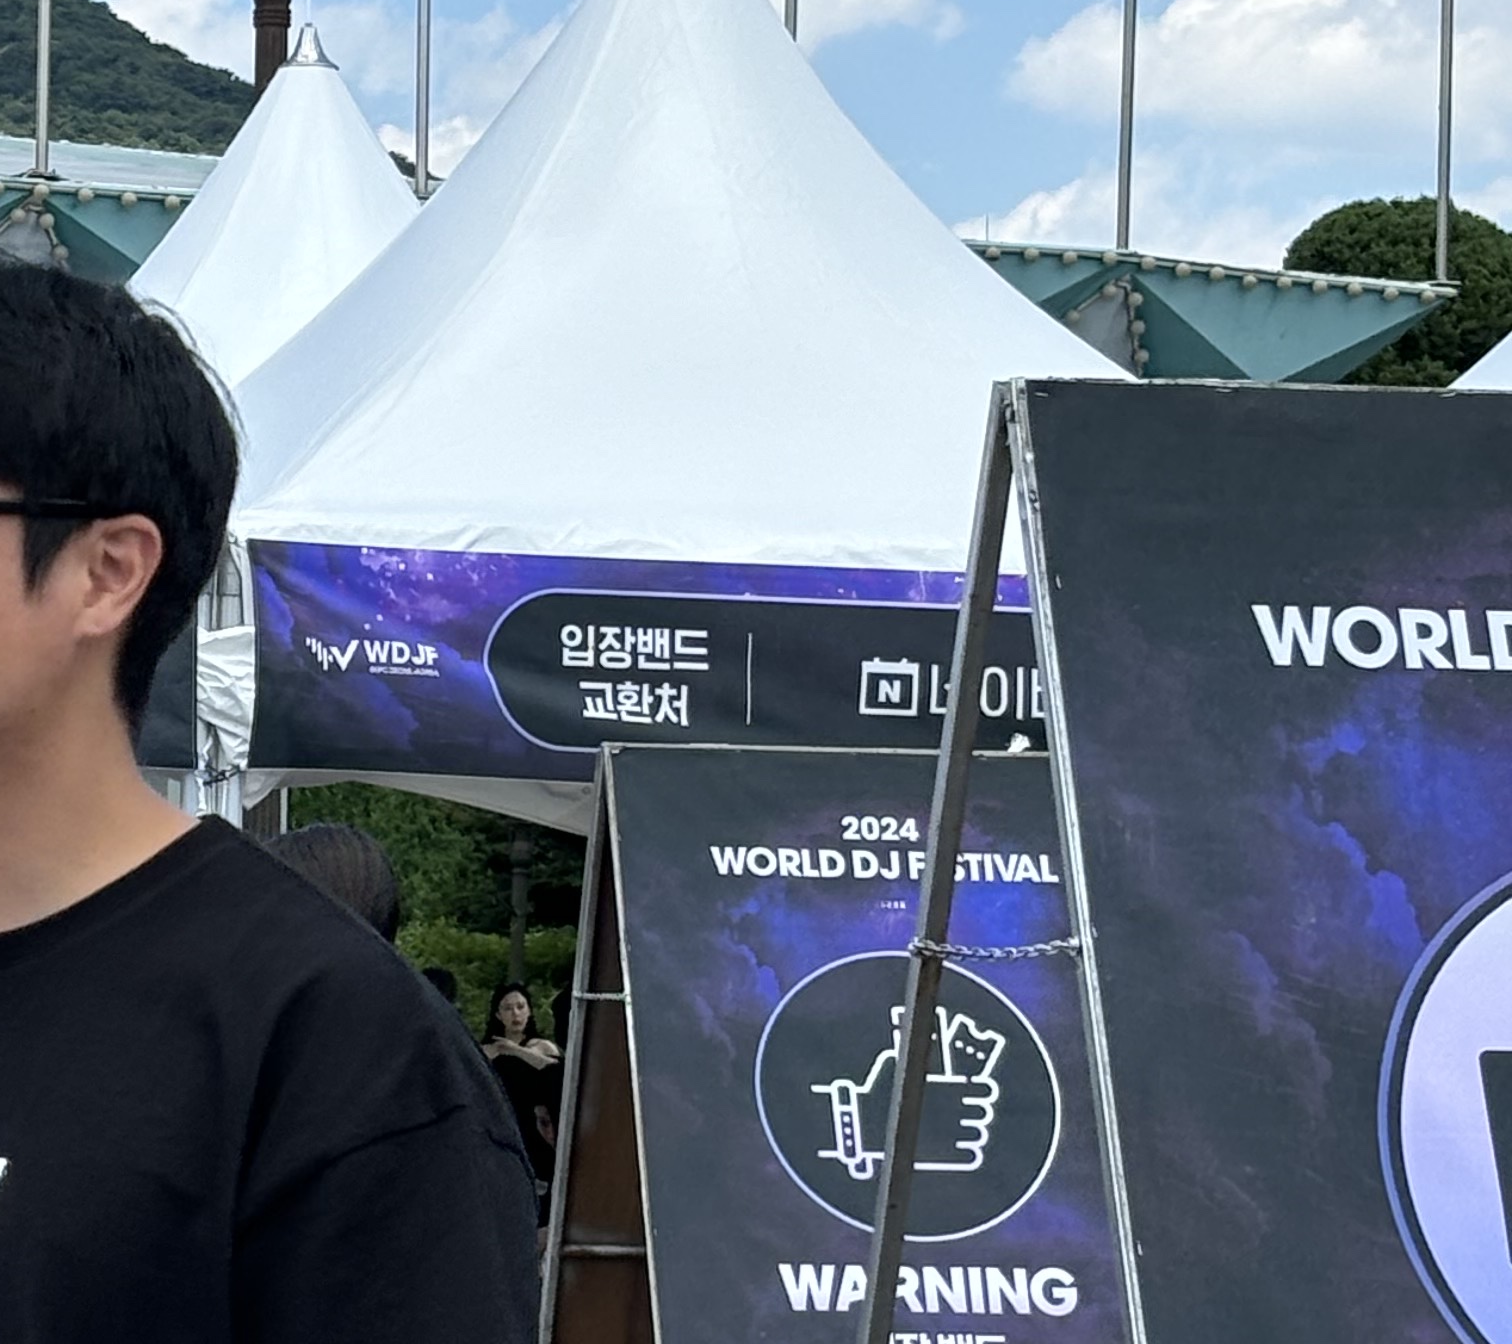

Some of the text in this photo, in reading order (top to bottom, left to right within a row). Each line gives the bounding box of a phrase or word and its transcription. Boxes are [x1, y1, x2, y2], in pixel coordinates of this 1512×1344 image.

[363, 639, 439, 666] WDJF
[560, 624, 710, 672] 입장밴드
[579, 681, 689, 727] 교환처
[841, 815, 920, 842] 2024
[710, 845, 1060, 884] WORLD DJ FSTIVAL
[778, 1263, 1078, 1316] WARNING
